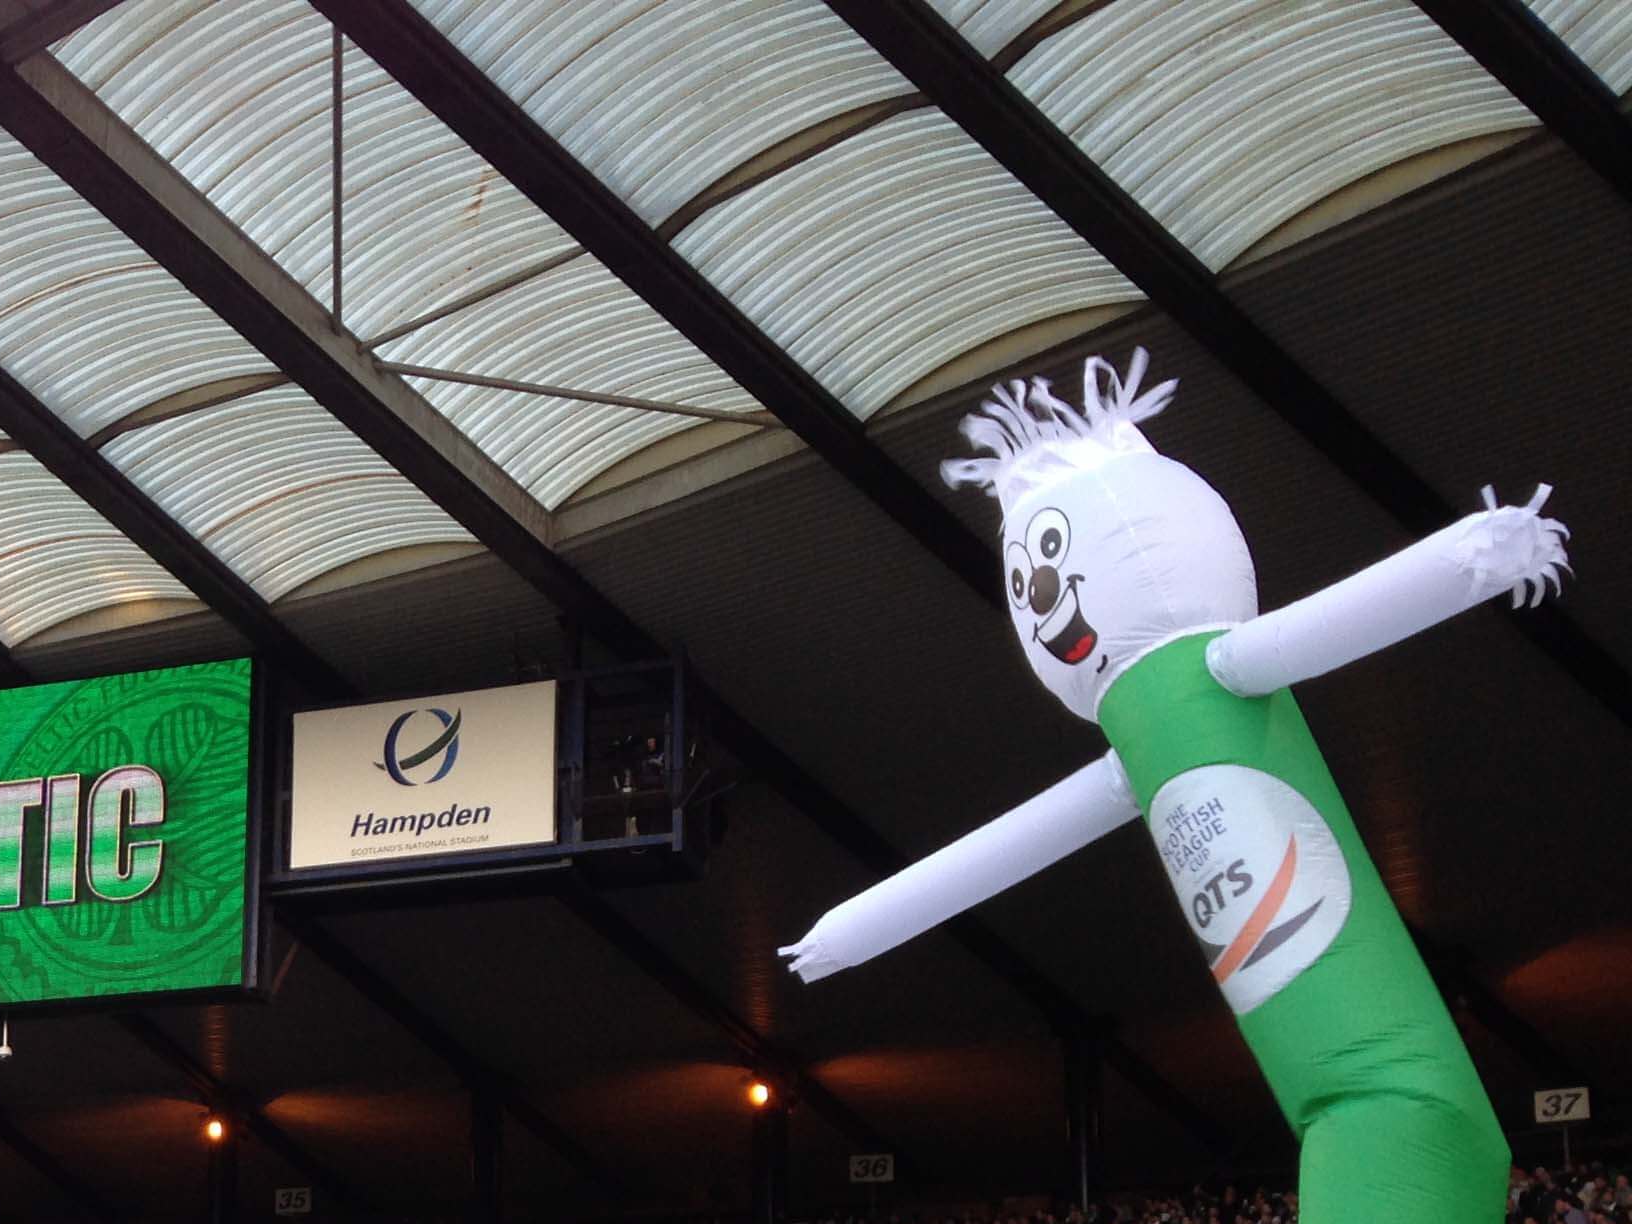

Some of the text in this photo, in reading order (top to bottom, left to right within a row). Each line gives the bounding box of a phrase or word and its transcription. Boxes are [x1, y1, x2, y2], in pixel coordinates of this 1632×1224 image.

[350, 803, 492, 837] Hampden
[1162, 797, 1225, 857] SCOTTISH
[1165, 803, 1188, 830] THE
[351, 835, 489, 857] SCOTLAND'S NATIONAL STADIUM
[1171, 817, 1227, 875] LEAGUE
[1189, 848, 1212, 873] CUP
[1192, 858, 1254, 929] QTS
[1542, 1092, 1584, 1117] 37
[279, 1190, 306, 1210] 35
